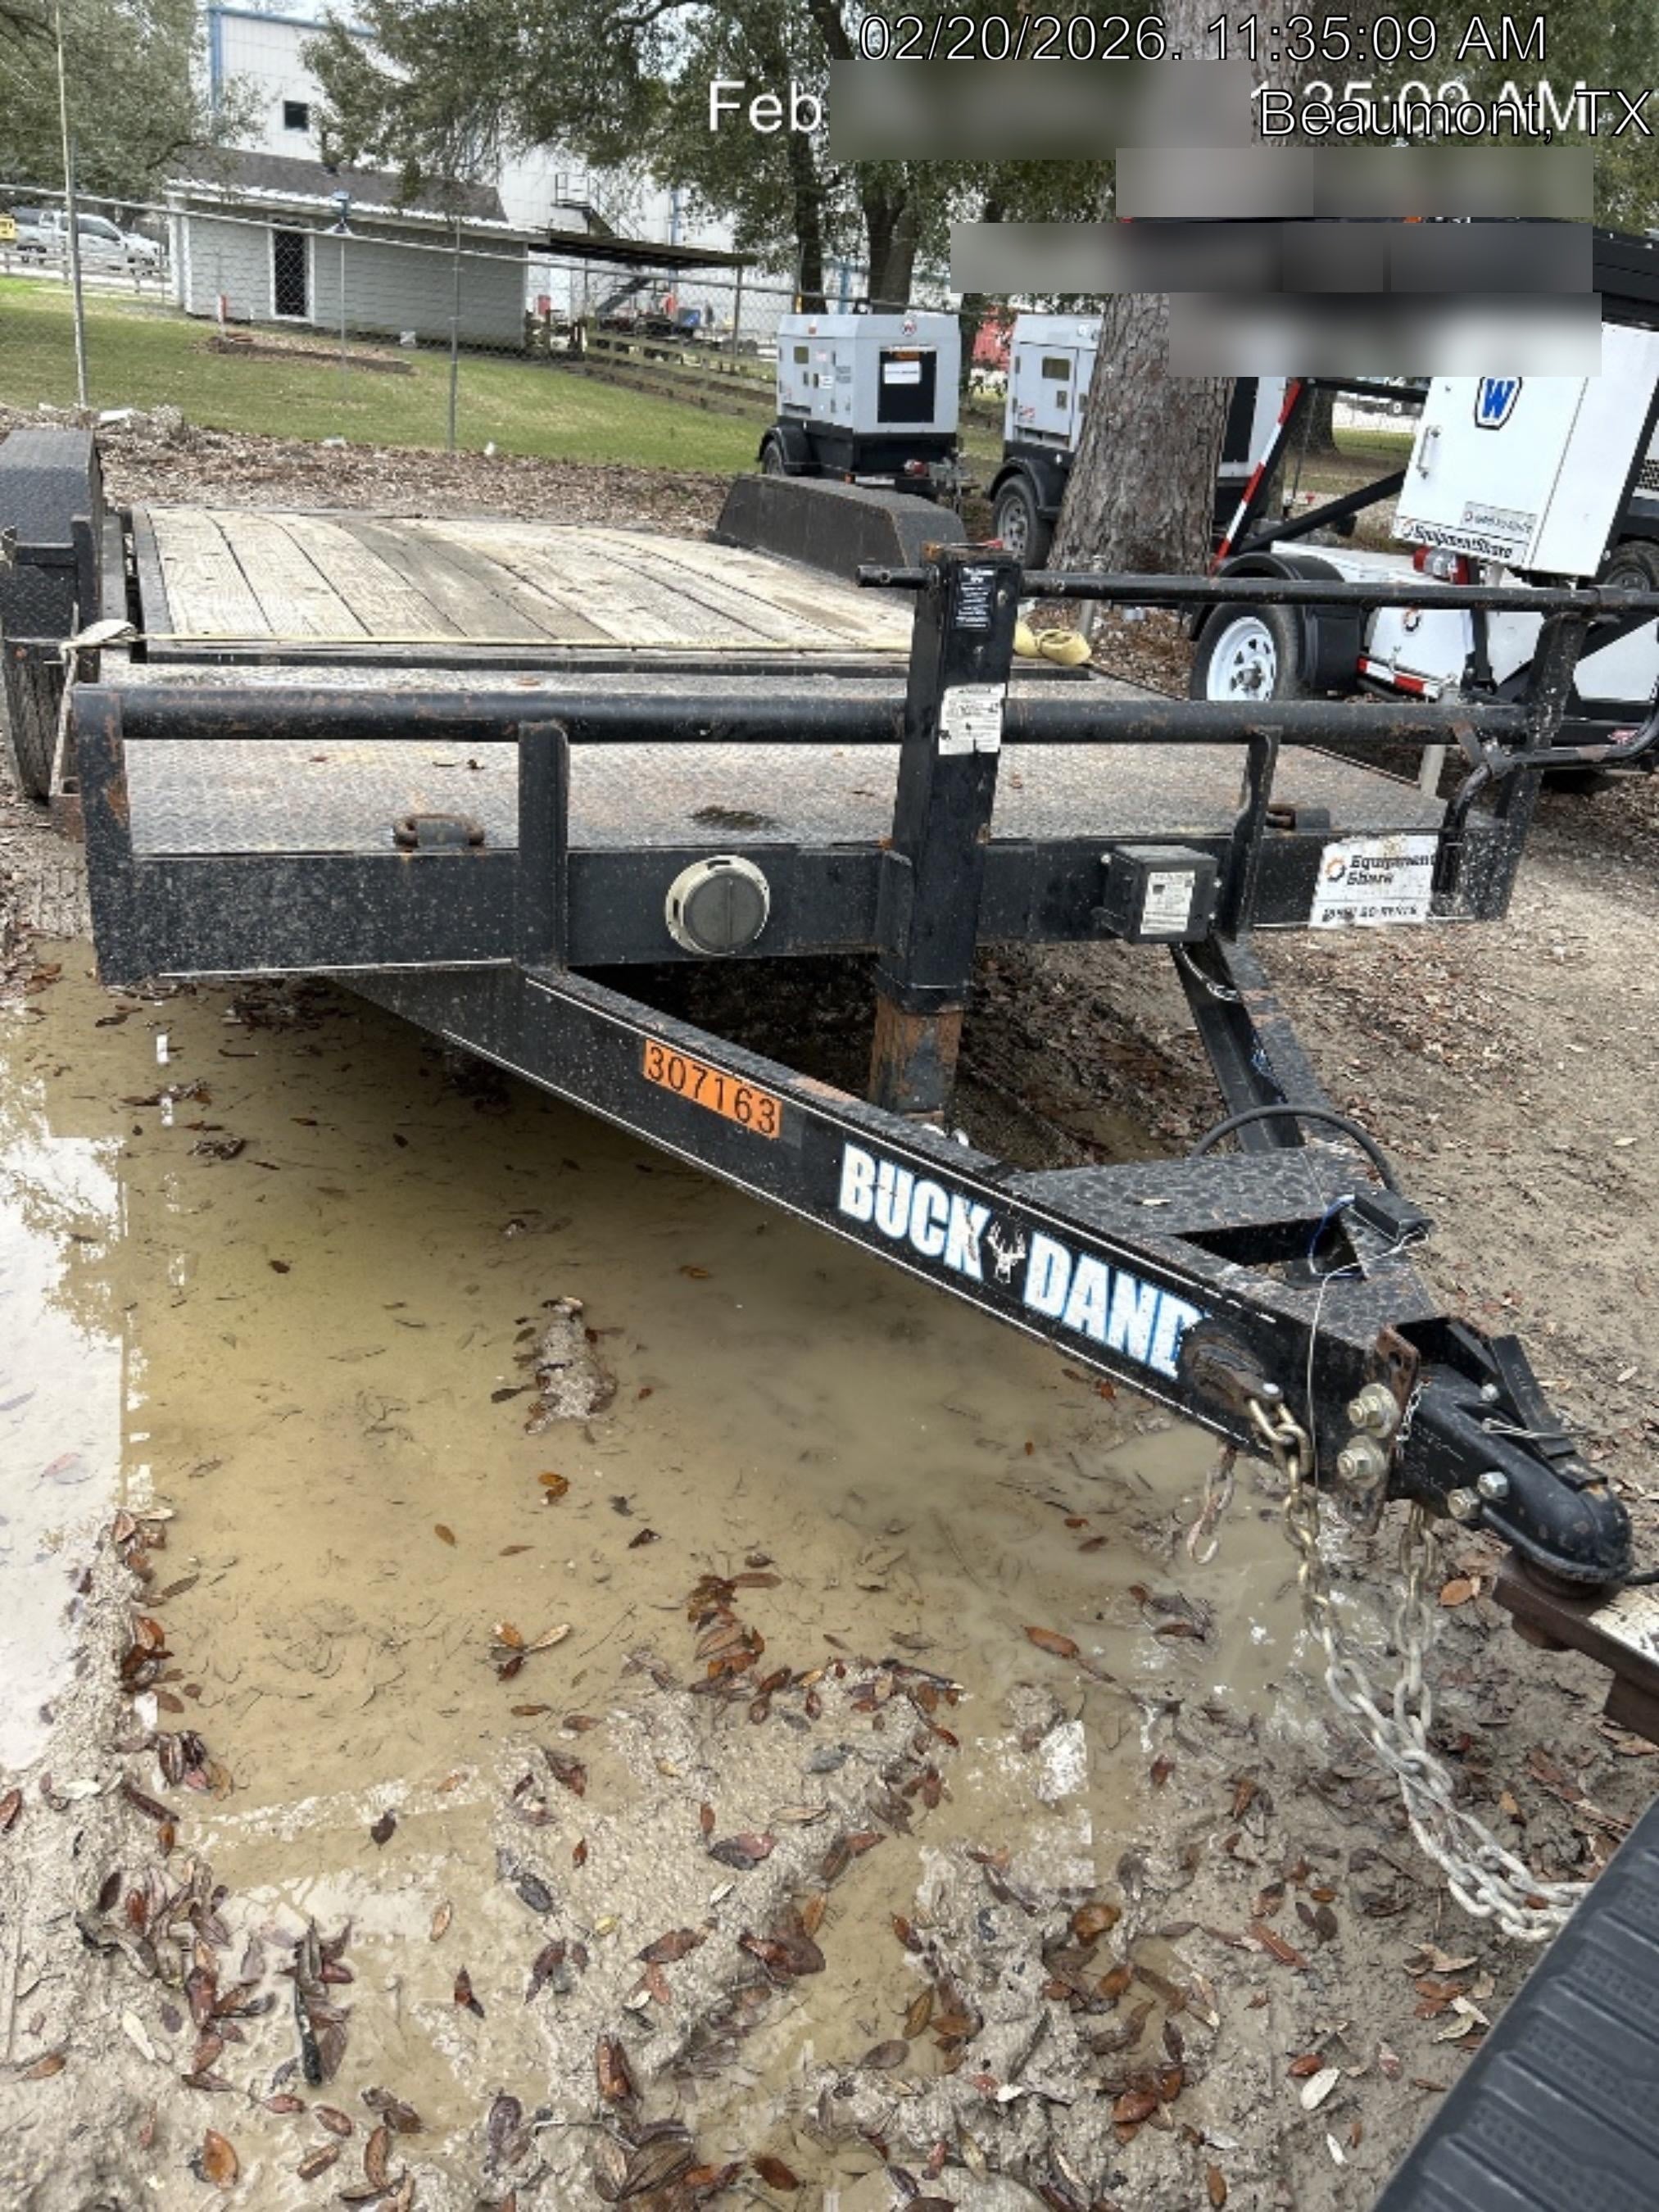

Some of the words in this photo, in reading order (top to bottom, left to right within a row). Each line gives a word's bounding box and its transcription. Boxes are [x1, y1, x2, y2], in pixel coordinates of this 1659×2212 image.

[1482, 378, 1515, 419] W
[648, 1046, 775, 1134] 307163
[839, 1143, 991, 1284] BUCK
